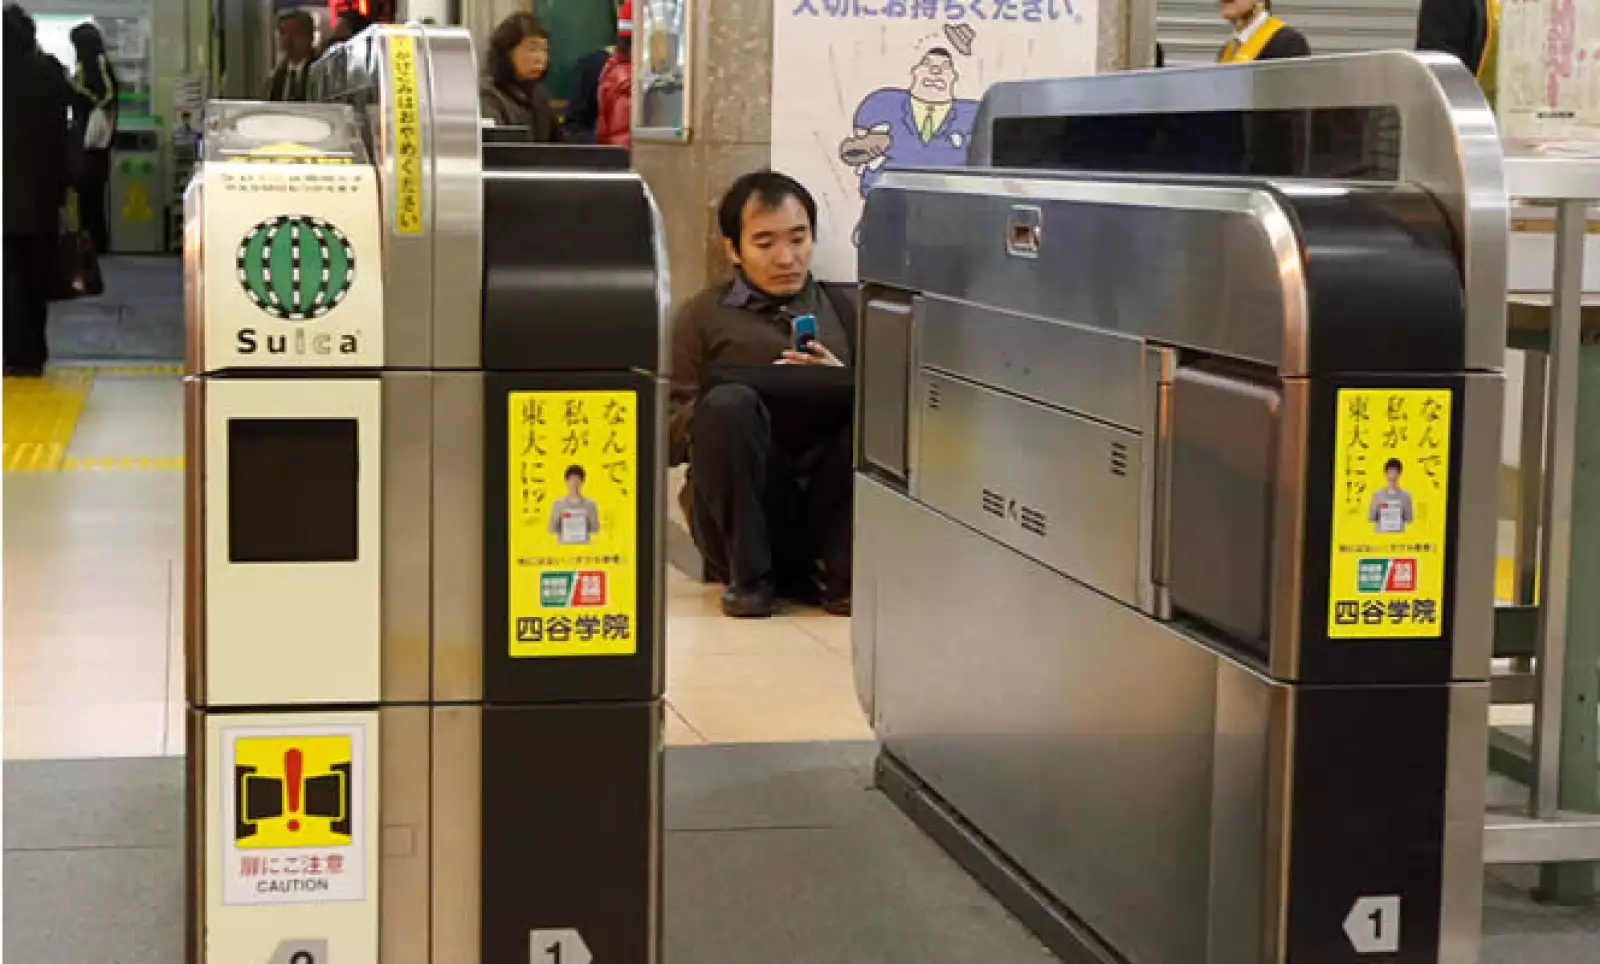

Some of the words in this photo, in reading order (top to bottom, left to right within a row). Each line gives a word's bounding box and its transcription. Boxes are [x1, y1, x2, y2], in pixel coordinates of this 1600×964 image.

[237, 328, 358, 354] Suica
[562, 399, 589, 456] 私が
[1382, 396, 1408, 449] 私が
[1335, 599, 1437, 625] 四谷学院
[517, 614, 630, 643] 四谷学院
[256, 878, 329, 893] CAUTION
[1368, 907, 1382, 940] 1
[545, 941, 561, 964] 1
